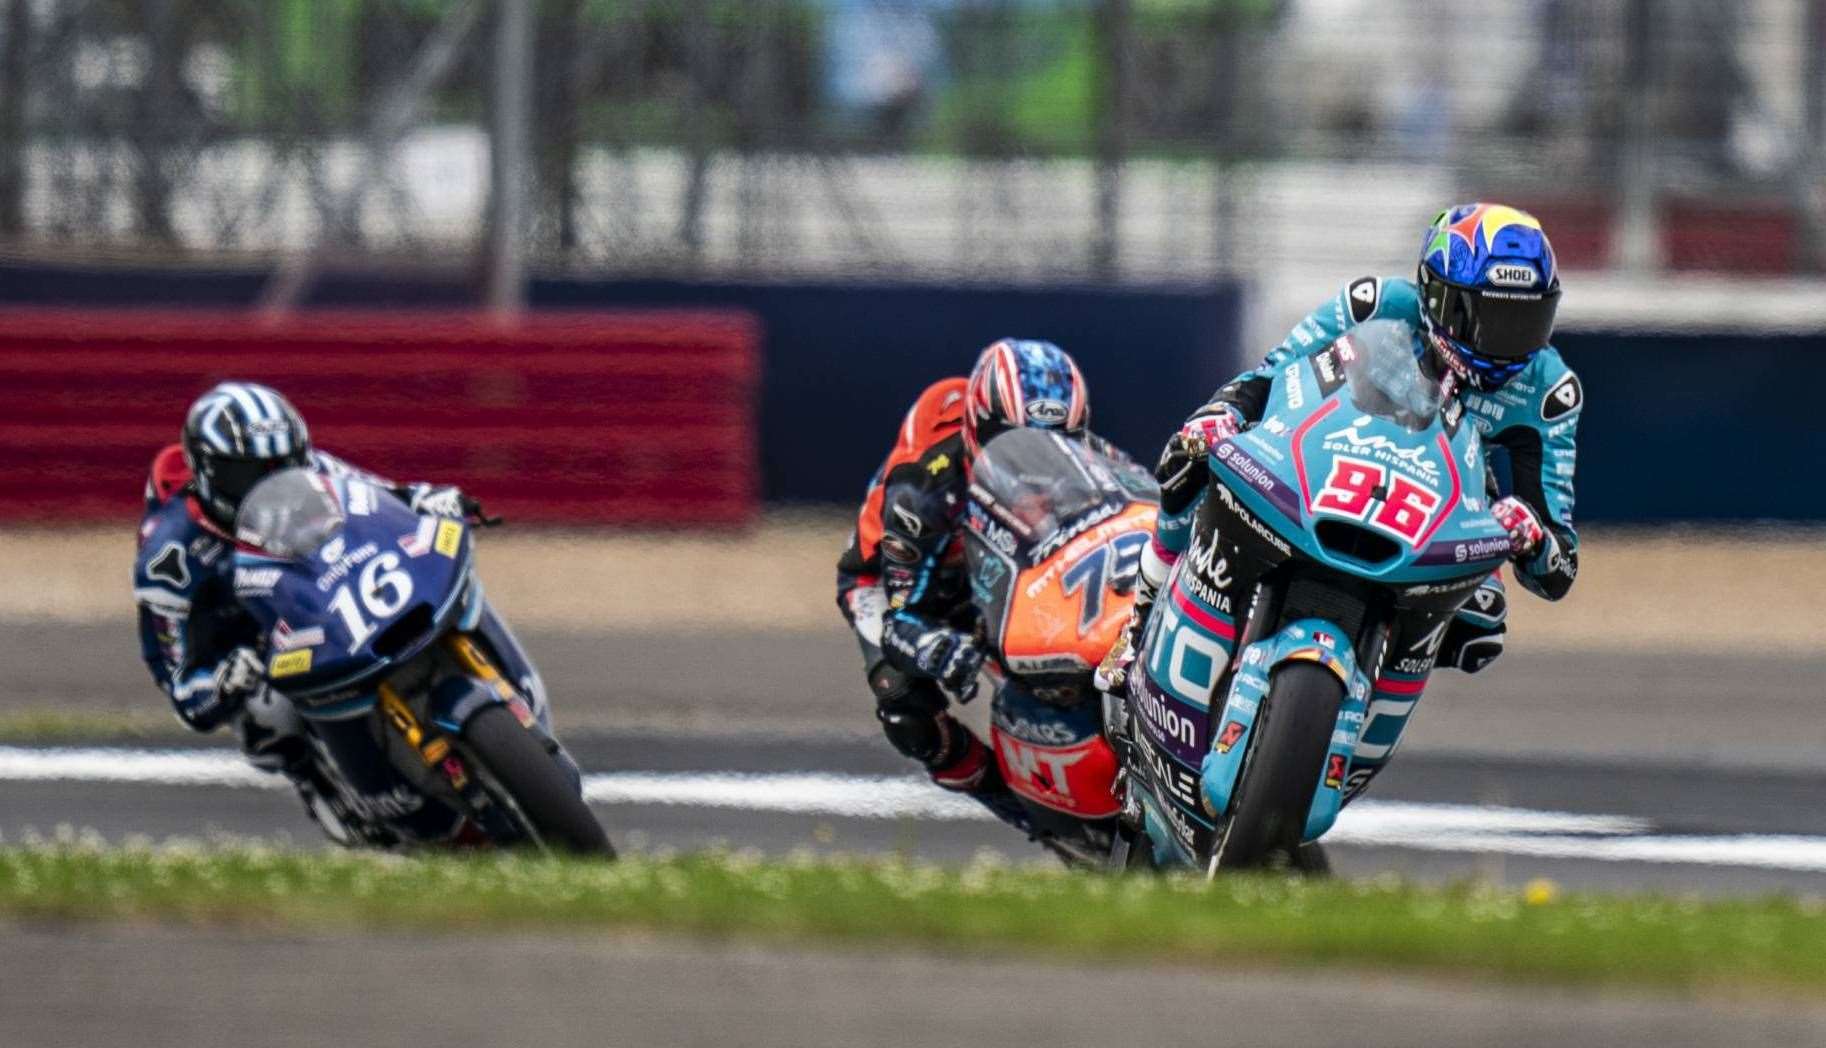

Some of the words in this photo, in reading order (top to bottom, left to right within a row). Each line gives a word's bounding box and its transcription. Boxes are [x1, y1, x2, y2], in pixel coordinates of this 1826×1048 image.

[1495, 267, 1532, 281] SHOEI
[1322, 440, 1372, 456] SOLER
[1374, 449, 1439, 488] HISPANIA
[1323, 414, 1440, 476] inde
[1229, 452, 1275, 491] solunion
[1310, 453, 1442, 546] 96
[1468, 538, 1510, 556] solunion
[327, 551, 413, 655] 16
